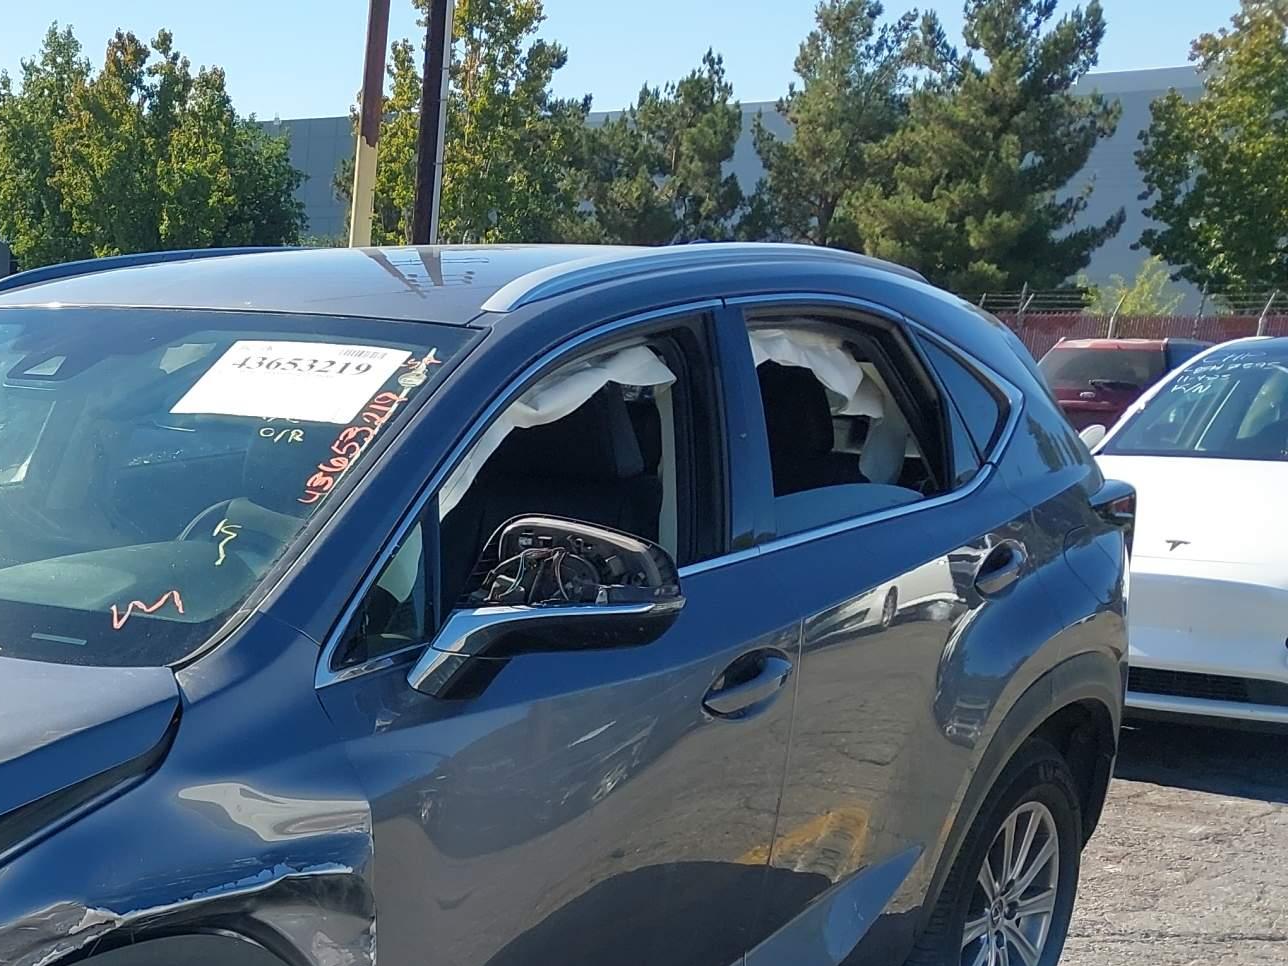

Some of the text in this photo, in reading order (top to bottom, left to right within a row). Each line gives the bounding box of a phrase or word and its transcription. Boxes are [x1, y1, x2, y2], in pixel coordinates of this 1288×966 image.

[232, 356, 373, 376] 43653219
[259, 427, 304, 443] O/R
[297, 391, 408, 503] 43653219
